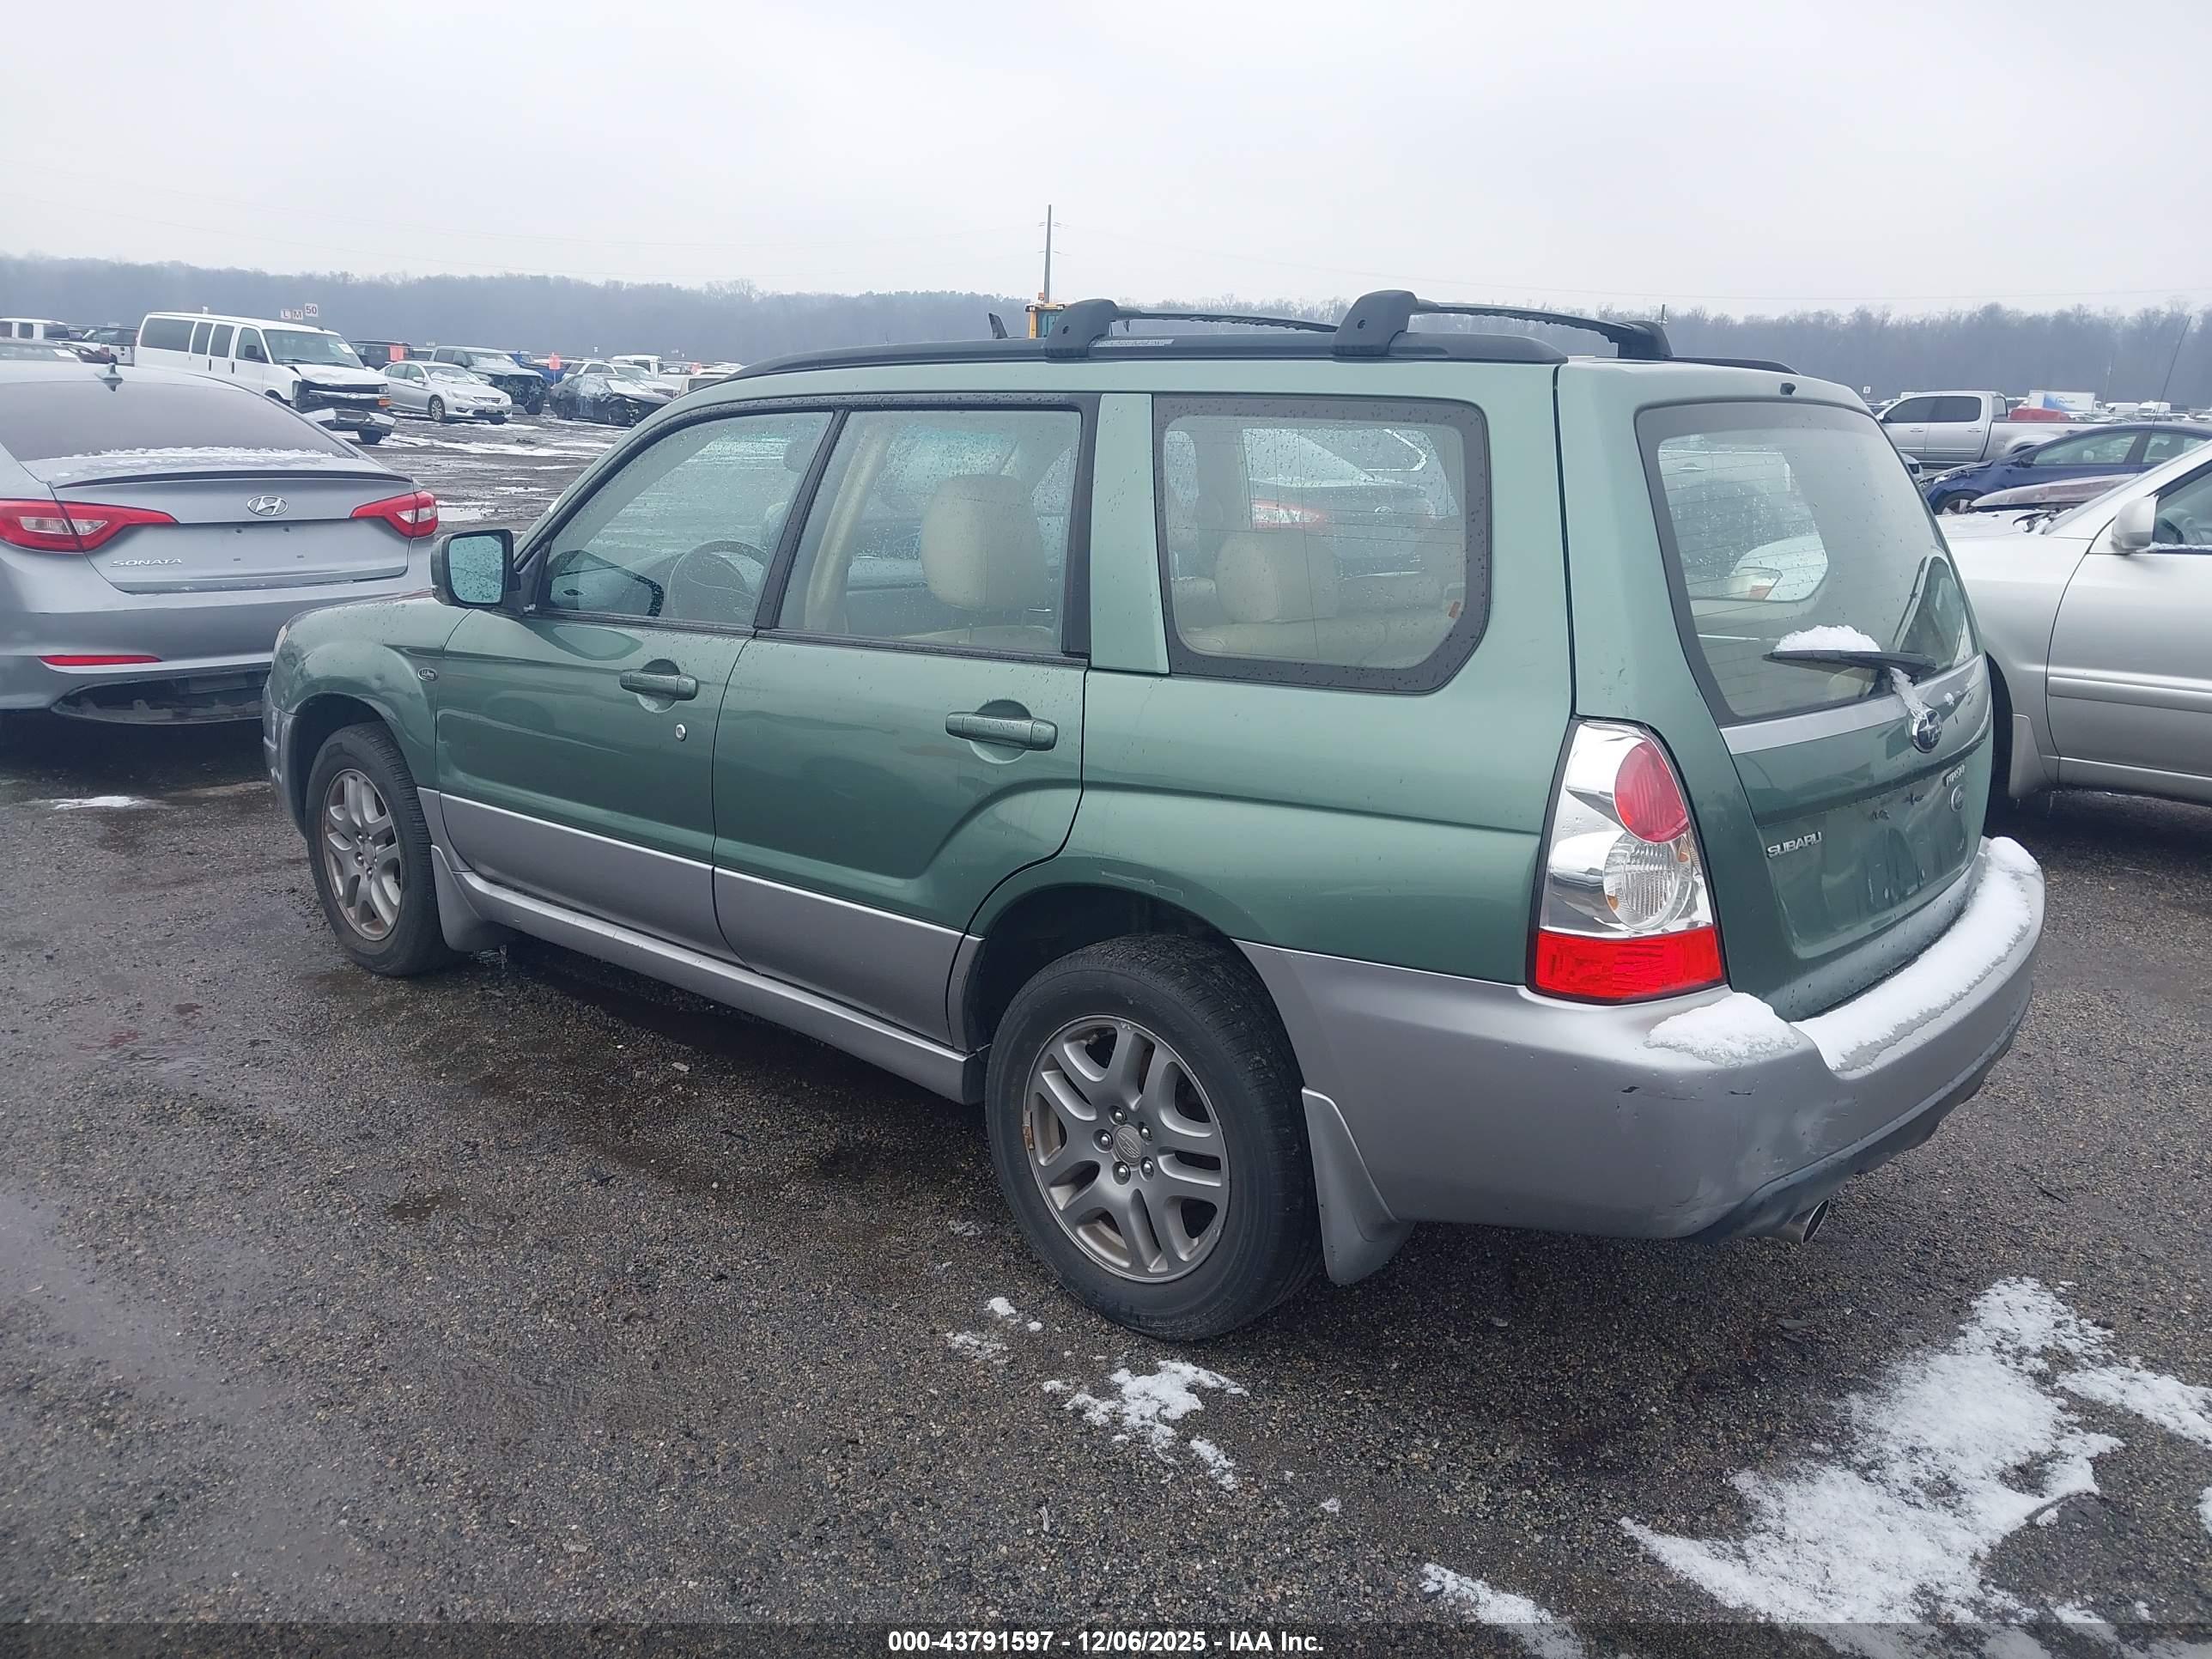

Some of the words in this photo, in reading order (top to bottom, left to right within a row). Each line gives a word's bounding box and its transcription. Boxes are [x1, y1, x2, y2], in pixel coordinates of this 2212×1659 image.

[306, 306, 318, 314] 50
[111, 558, 183, 568] SONATA
[1767, 830, 1822, 859] SUBARU
